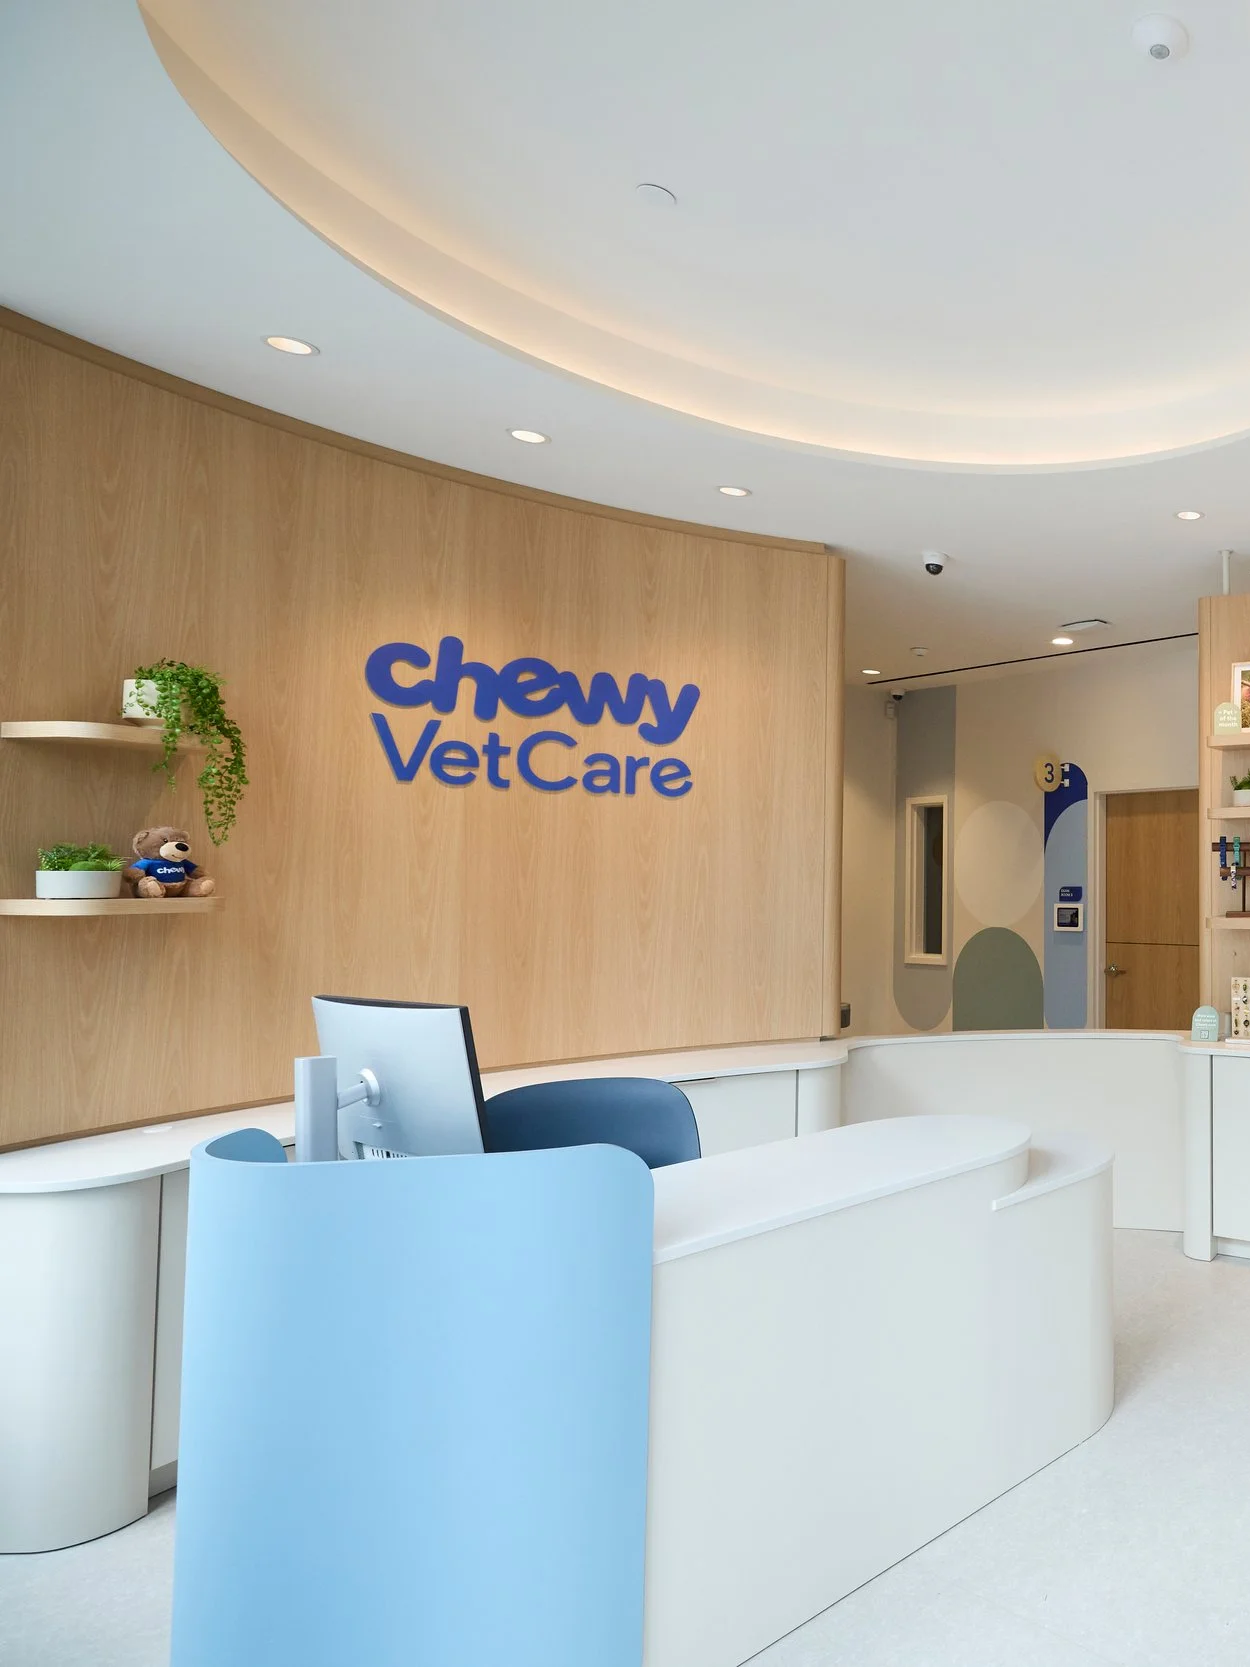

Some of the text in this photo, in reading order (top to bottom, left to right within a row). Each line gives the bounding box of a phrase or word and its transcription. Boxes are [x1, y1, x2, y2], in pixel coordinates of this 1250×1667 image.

[365, 636, 700, 745] chewy
[371, 712, 693, 797] VetCare
[1044, 762, 1054, 784] 3
